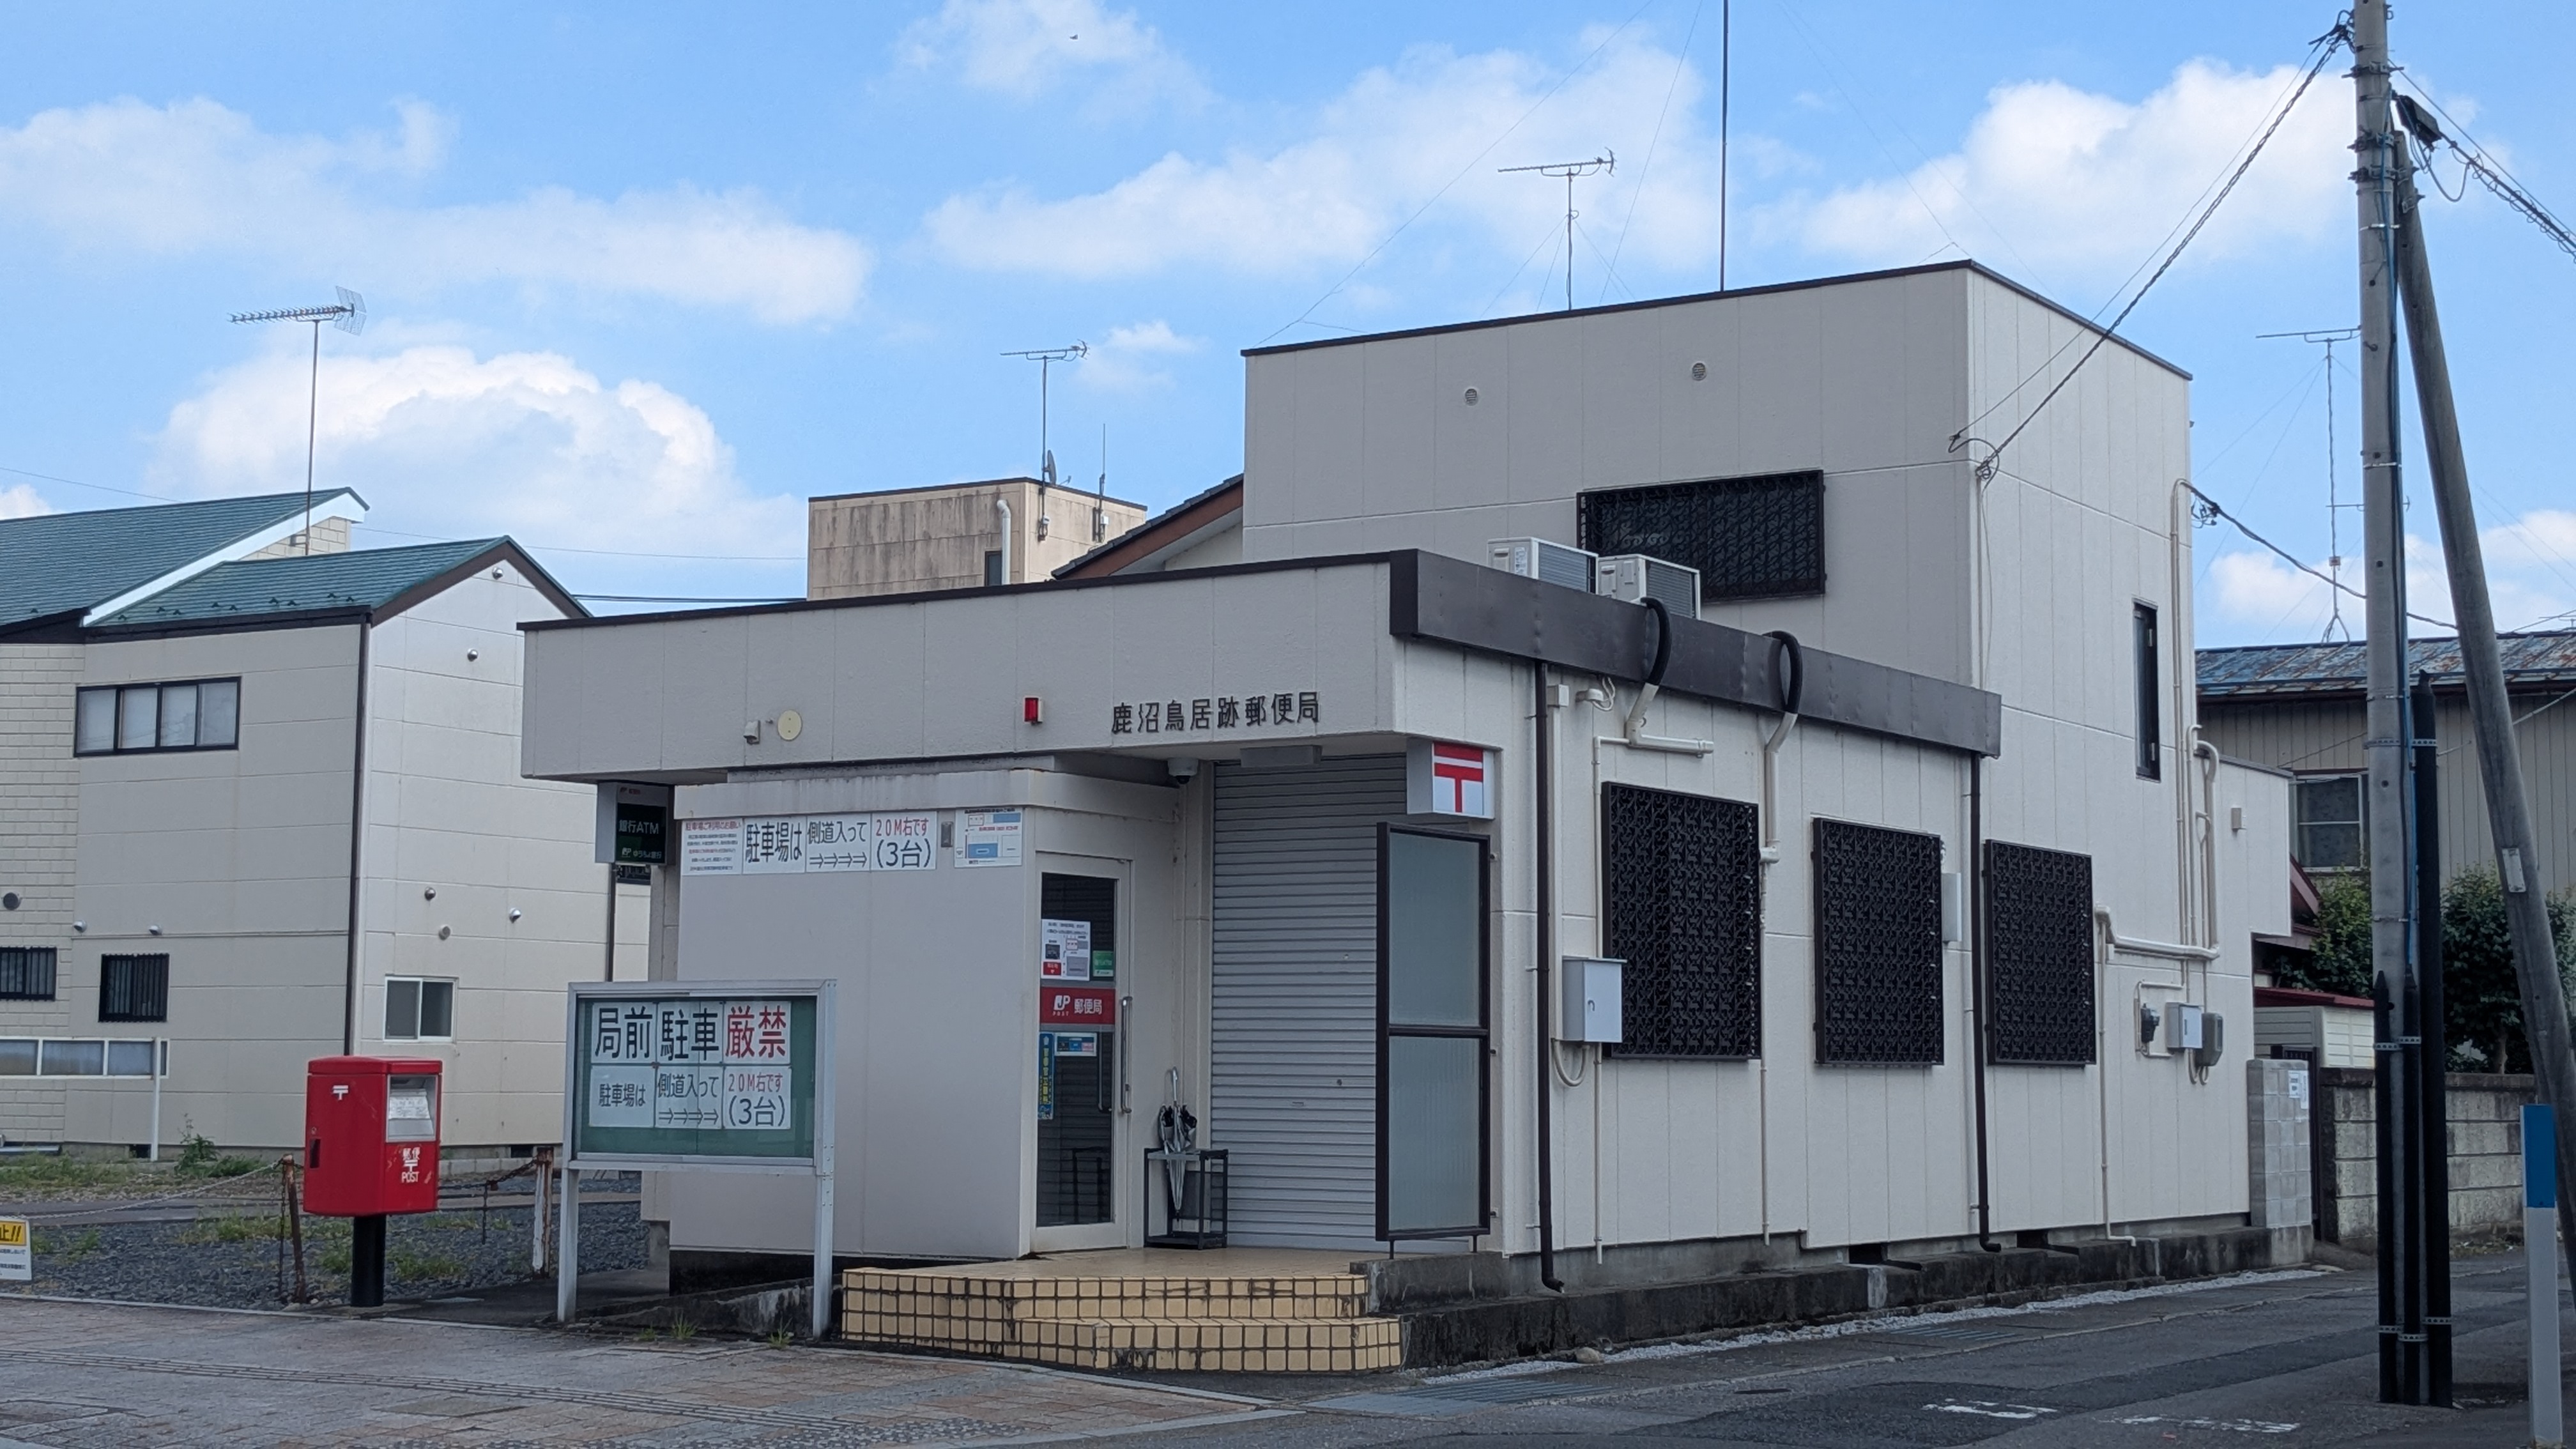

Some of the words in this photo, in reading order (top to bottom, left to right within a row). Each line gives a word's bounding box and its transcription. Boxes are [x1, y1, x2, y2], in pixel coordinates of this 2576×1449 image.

[1112, 691, 1320, 735] 鹿沼鳥居跡郵便局
[745, 821, 802, 863] 駐車場は
[807, 820, 868, 845] 側道入って
[877, 838, 931, 868] (3台)
[1074, 998, 1102, 1015] 郵便局
[599, 1084, 646, 1107] 駐車場は
[658, 1073, 719, 1098] 側道入って
[729, 1095, 785, 1127] (3台)
[402, 1147, 420, 1160] 郵便
[401, 1172, 419, 1183] POST
